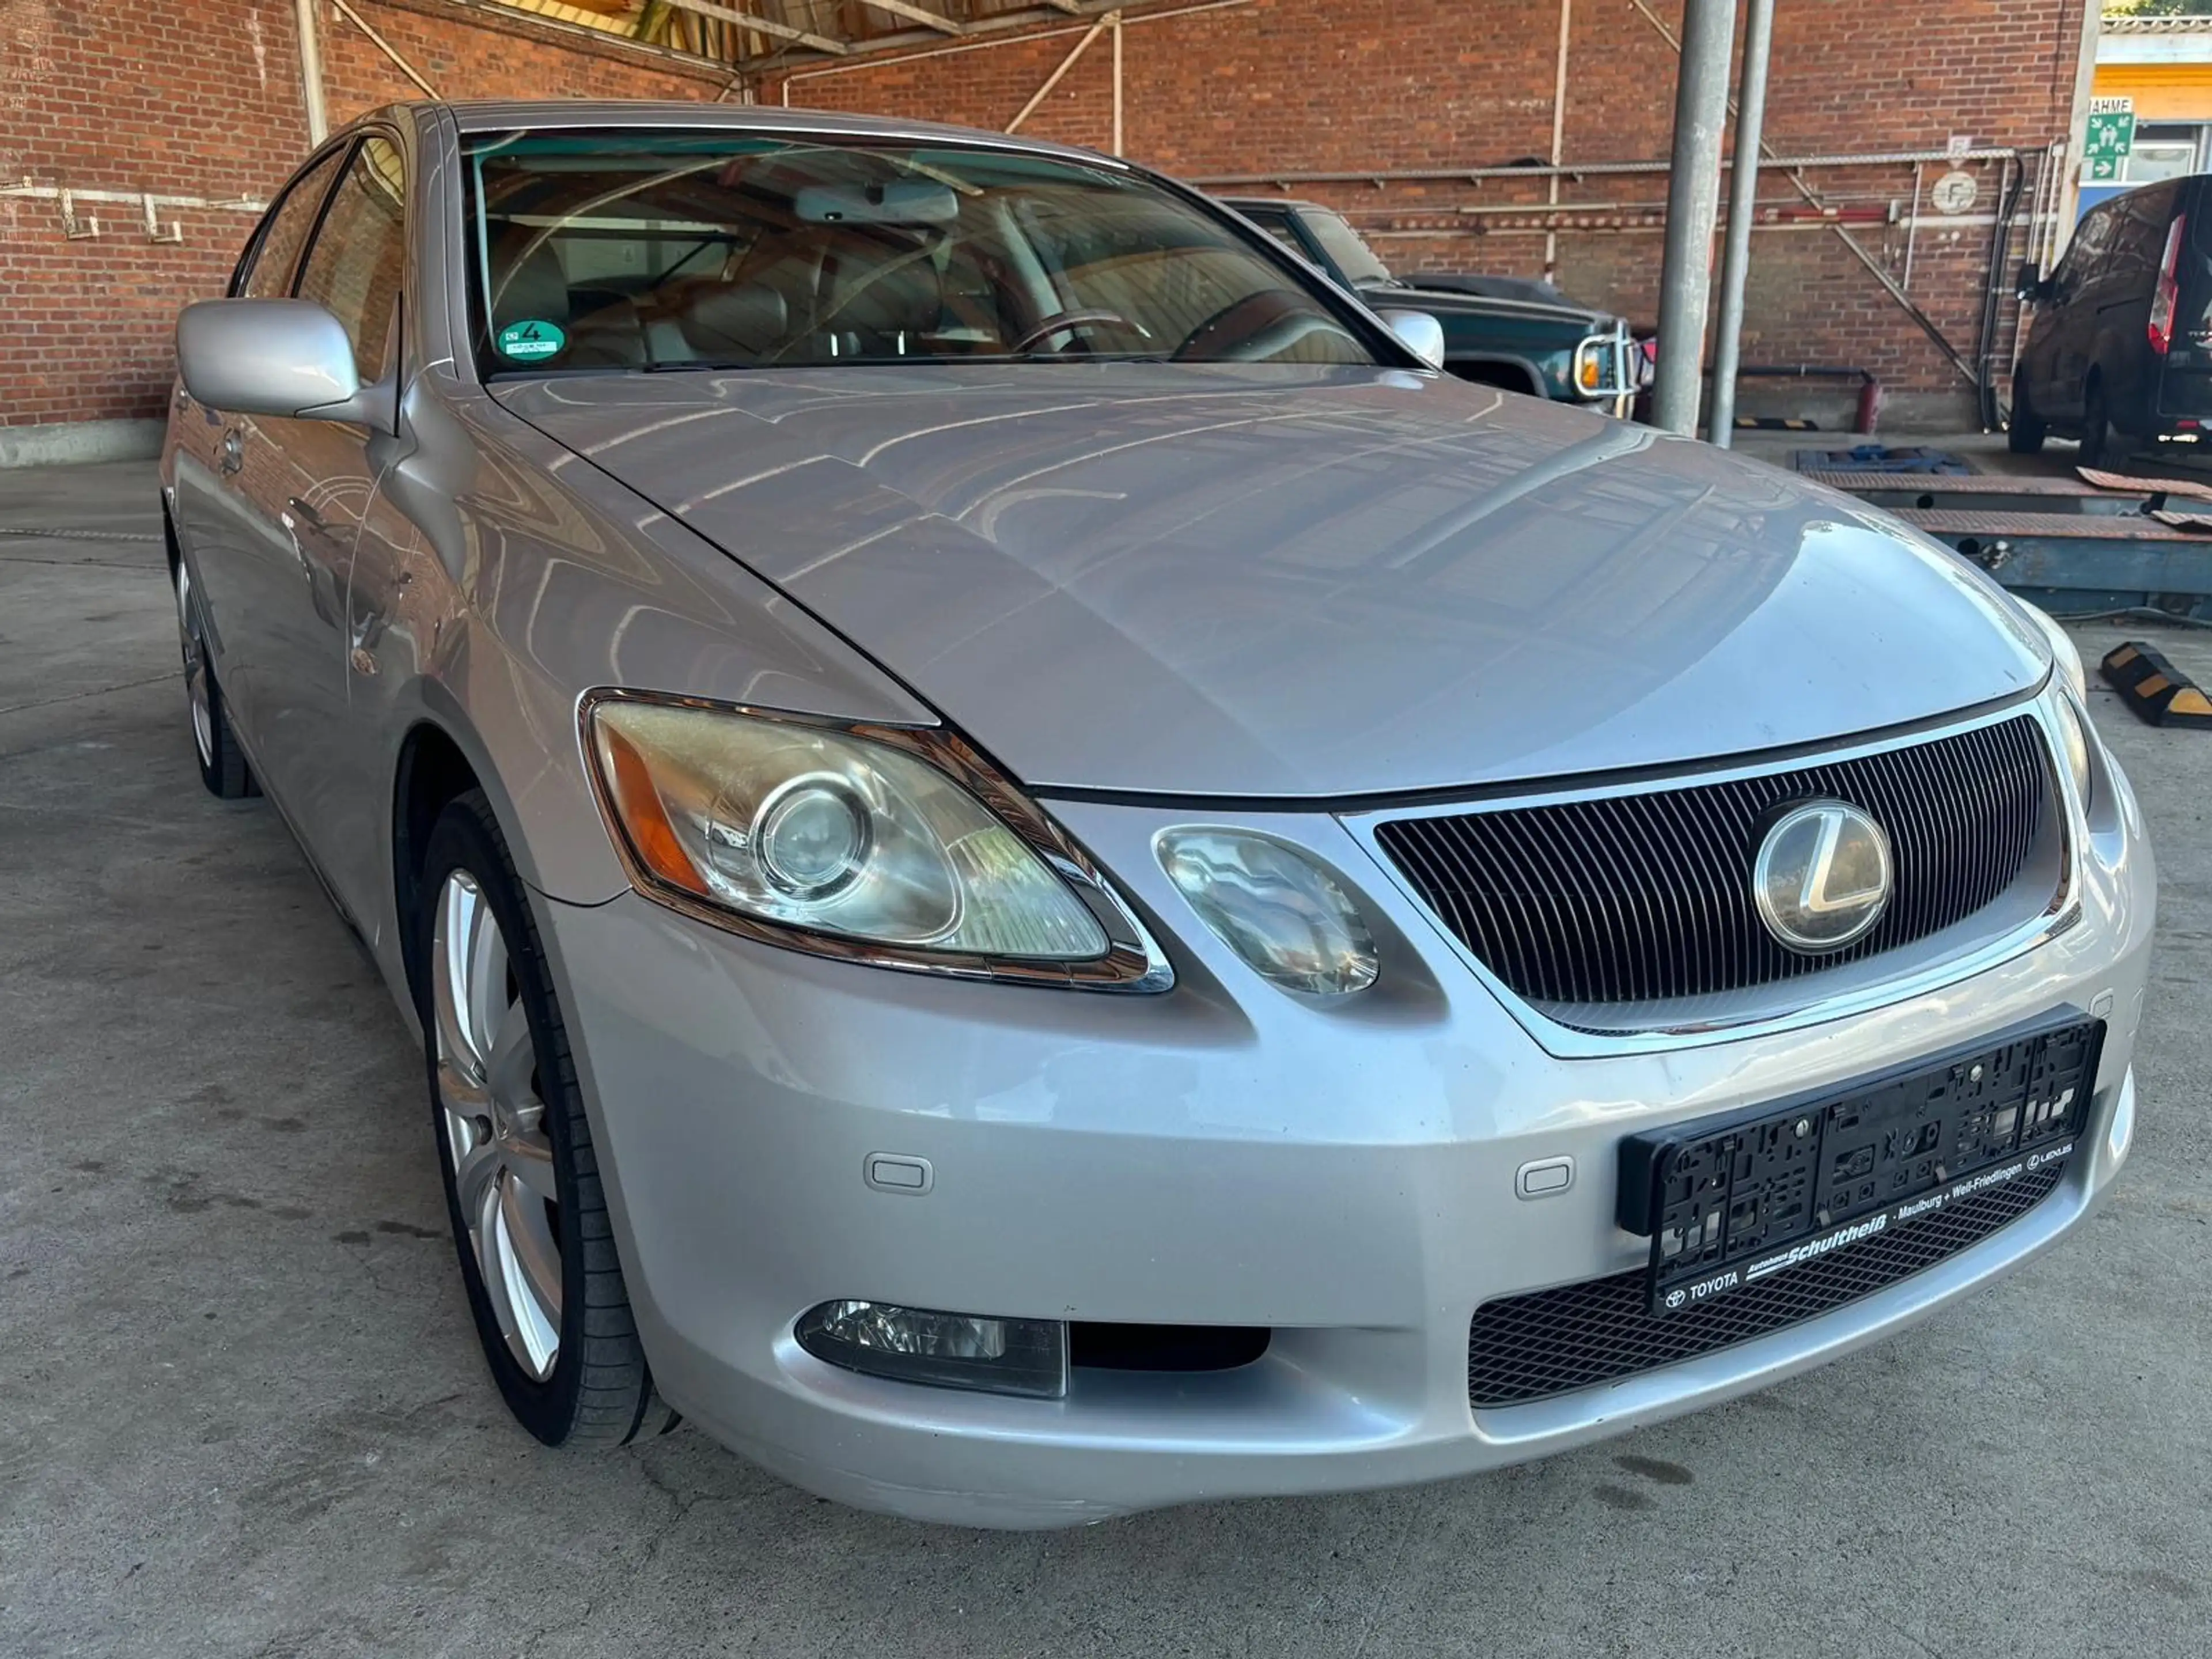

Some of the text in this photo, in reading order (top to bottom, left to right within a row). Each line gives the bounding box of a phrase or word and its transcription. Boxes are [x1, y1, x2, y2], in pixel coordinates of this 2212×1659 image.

[2088, 99, 2130, 113] AHME
[522, 322, 541, 340] 4
[1690, 1271, 1738, 1300] TOYOTA
[1787, 1214, 1887, 1262] Schultheiß
[1898, 1194, 1942, 1220] Maulburg
[1952, 1163, 2022, 1198] Weil-Friedlingen
[2040, 1142, 2073, 1162] LEXUS
